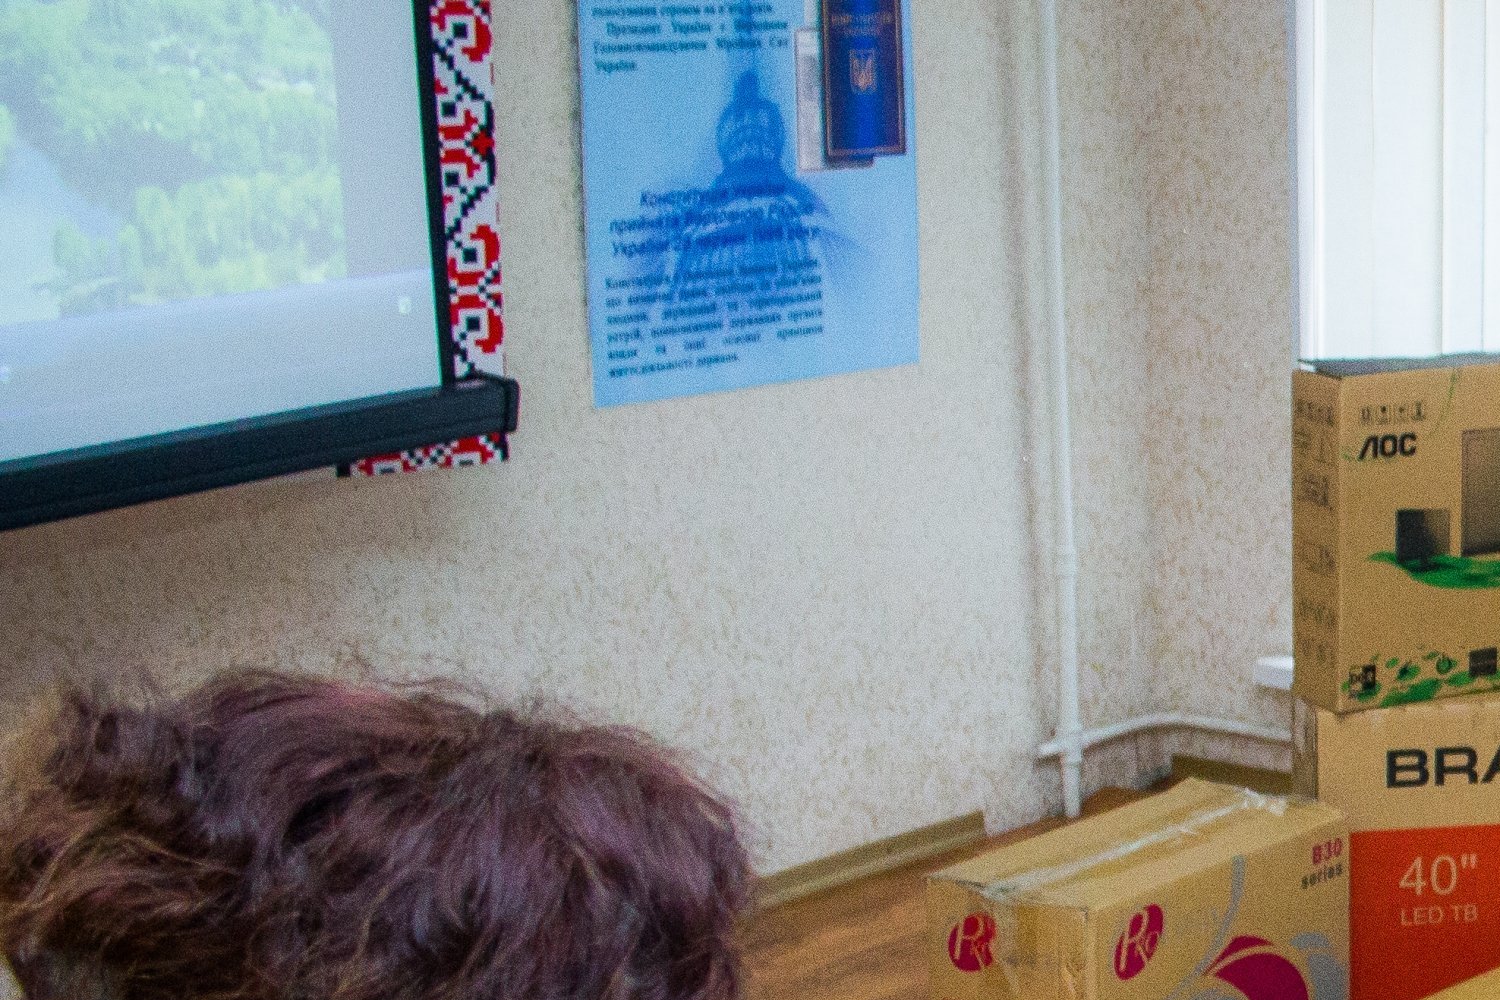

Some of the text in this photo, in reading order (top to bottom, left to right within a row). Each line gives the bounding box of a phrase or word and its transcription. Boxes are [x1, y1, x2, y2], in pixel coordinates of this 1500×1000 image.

[1357, 432, 1418, 462] AOC
[1312, 837, 1343, 865] B30
[1301, 862, 1343, 890] series
[1399, 852, 1478, 898] 40"
[1400, 903, 1442, 927] LED
